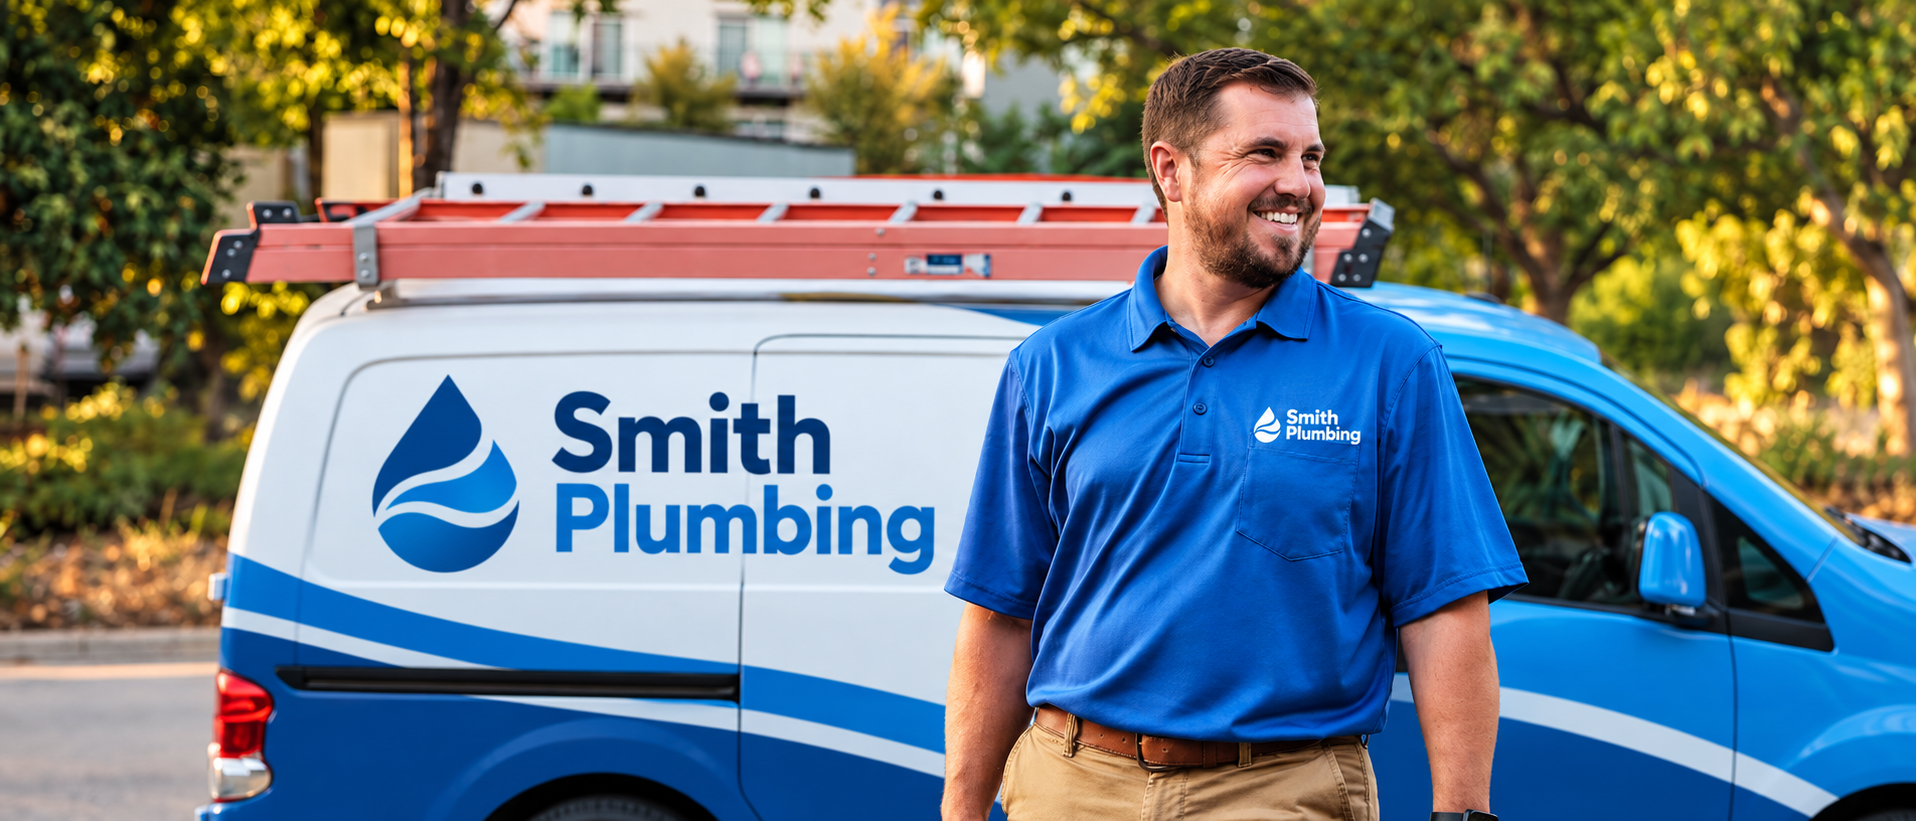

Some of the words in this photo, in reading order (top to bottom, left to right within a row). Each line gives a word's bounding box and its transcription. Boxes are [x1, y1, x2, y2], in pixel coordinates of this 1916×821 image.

[552, 391, 830, 475] Smith
[1286, 426, 1360, 444] Plumbing
[1287, 409, 1338, 425] Smith
[556, 483, 934, 574] Plumbing
